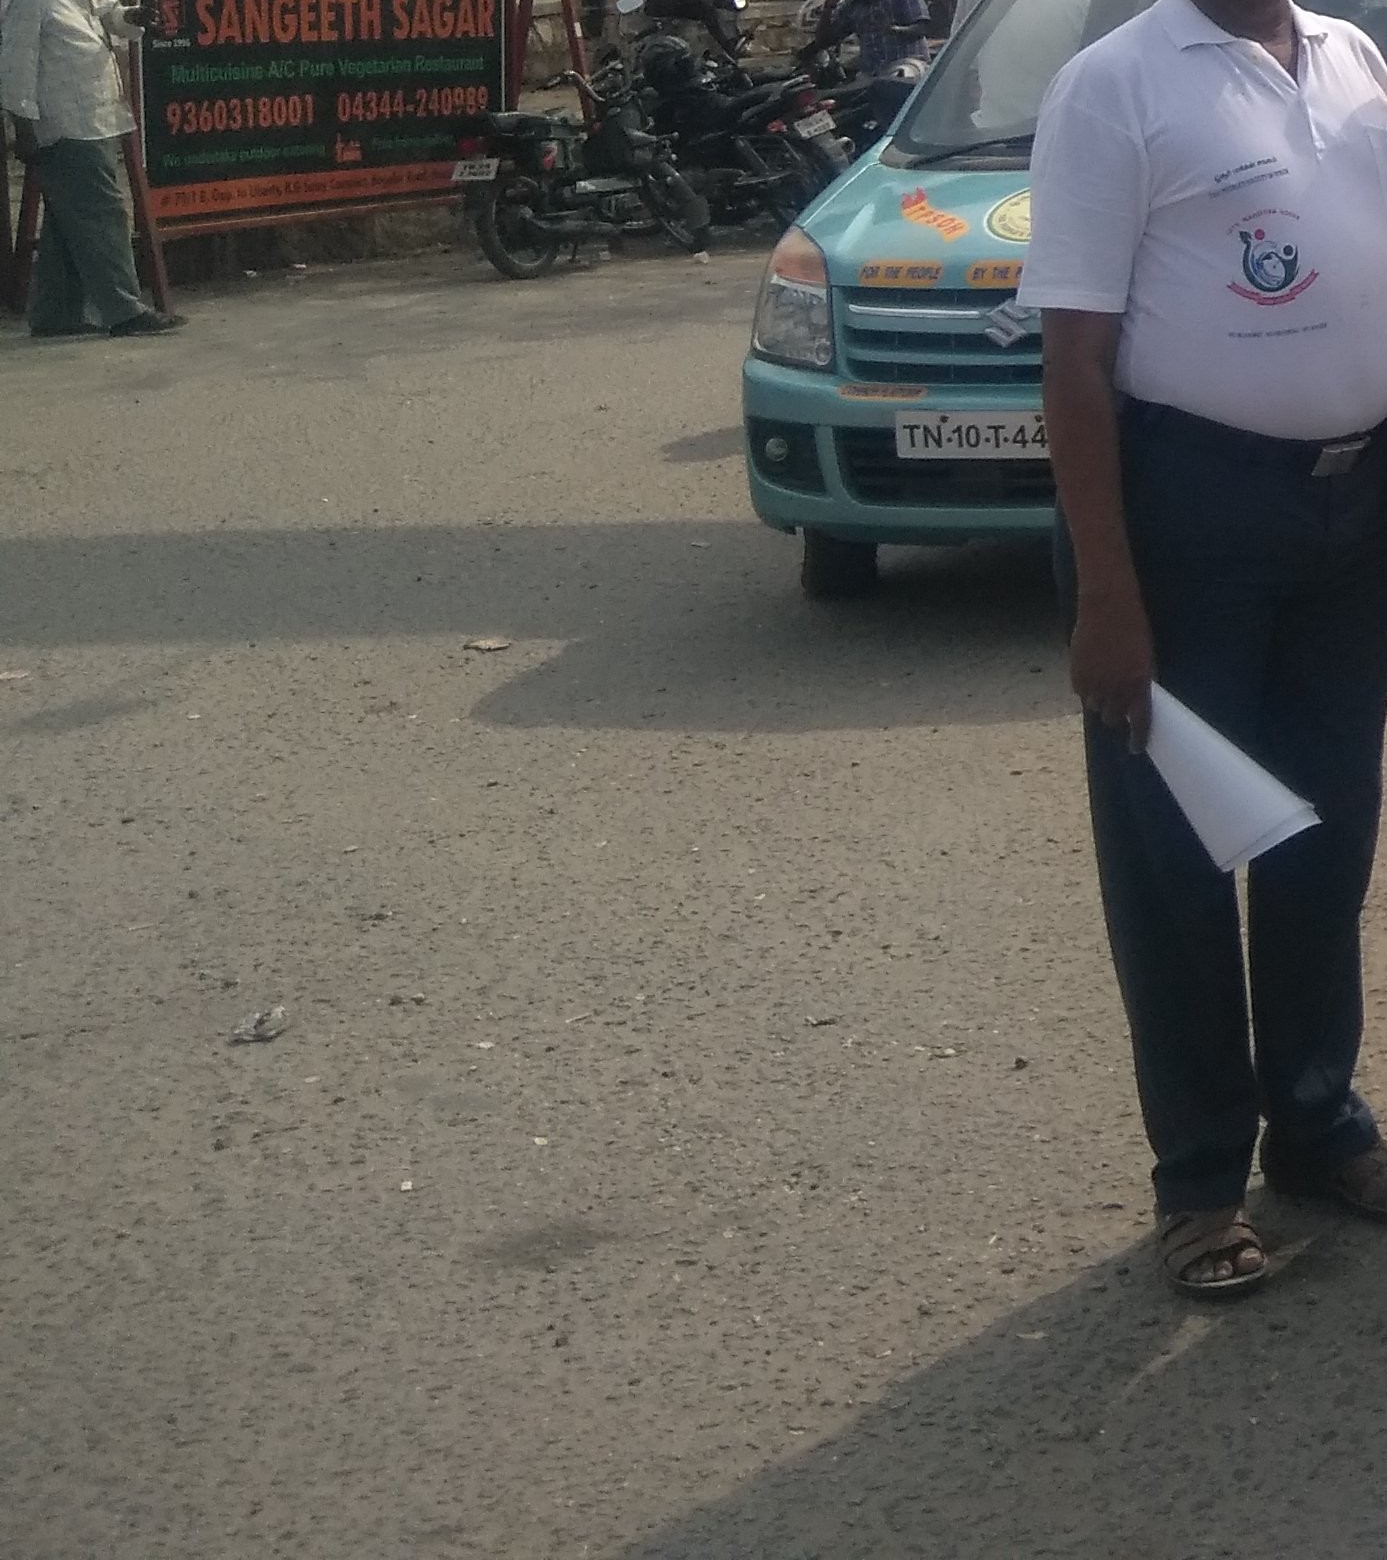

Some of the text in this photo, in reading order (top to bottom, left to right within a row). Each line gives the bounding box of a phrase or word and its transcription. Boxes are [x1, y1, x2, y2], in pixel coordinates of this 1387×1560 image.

[299, 59, 335, 78] Pure
[337, 56, 412, 79] Vegetarian
[414, 54, 485, 73] Restaurant
[165, 85, 489, 135] 9360318001 04344-240989
[884, 265, 903, 280] THE
[905, 265, 943, 281] PEOPLE
[971, 265, 1010, 281] BY THE
